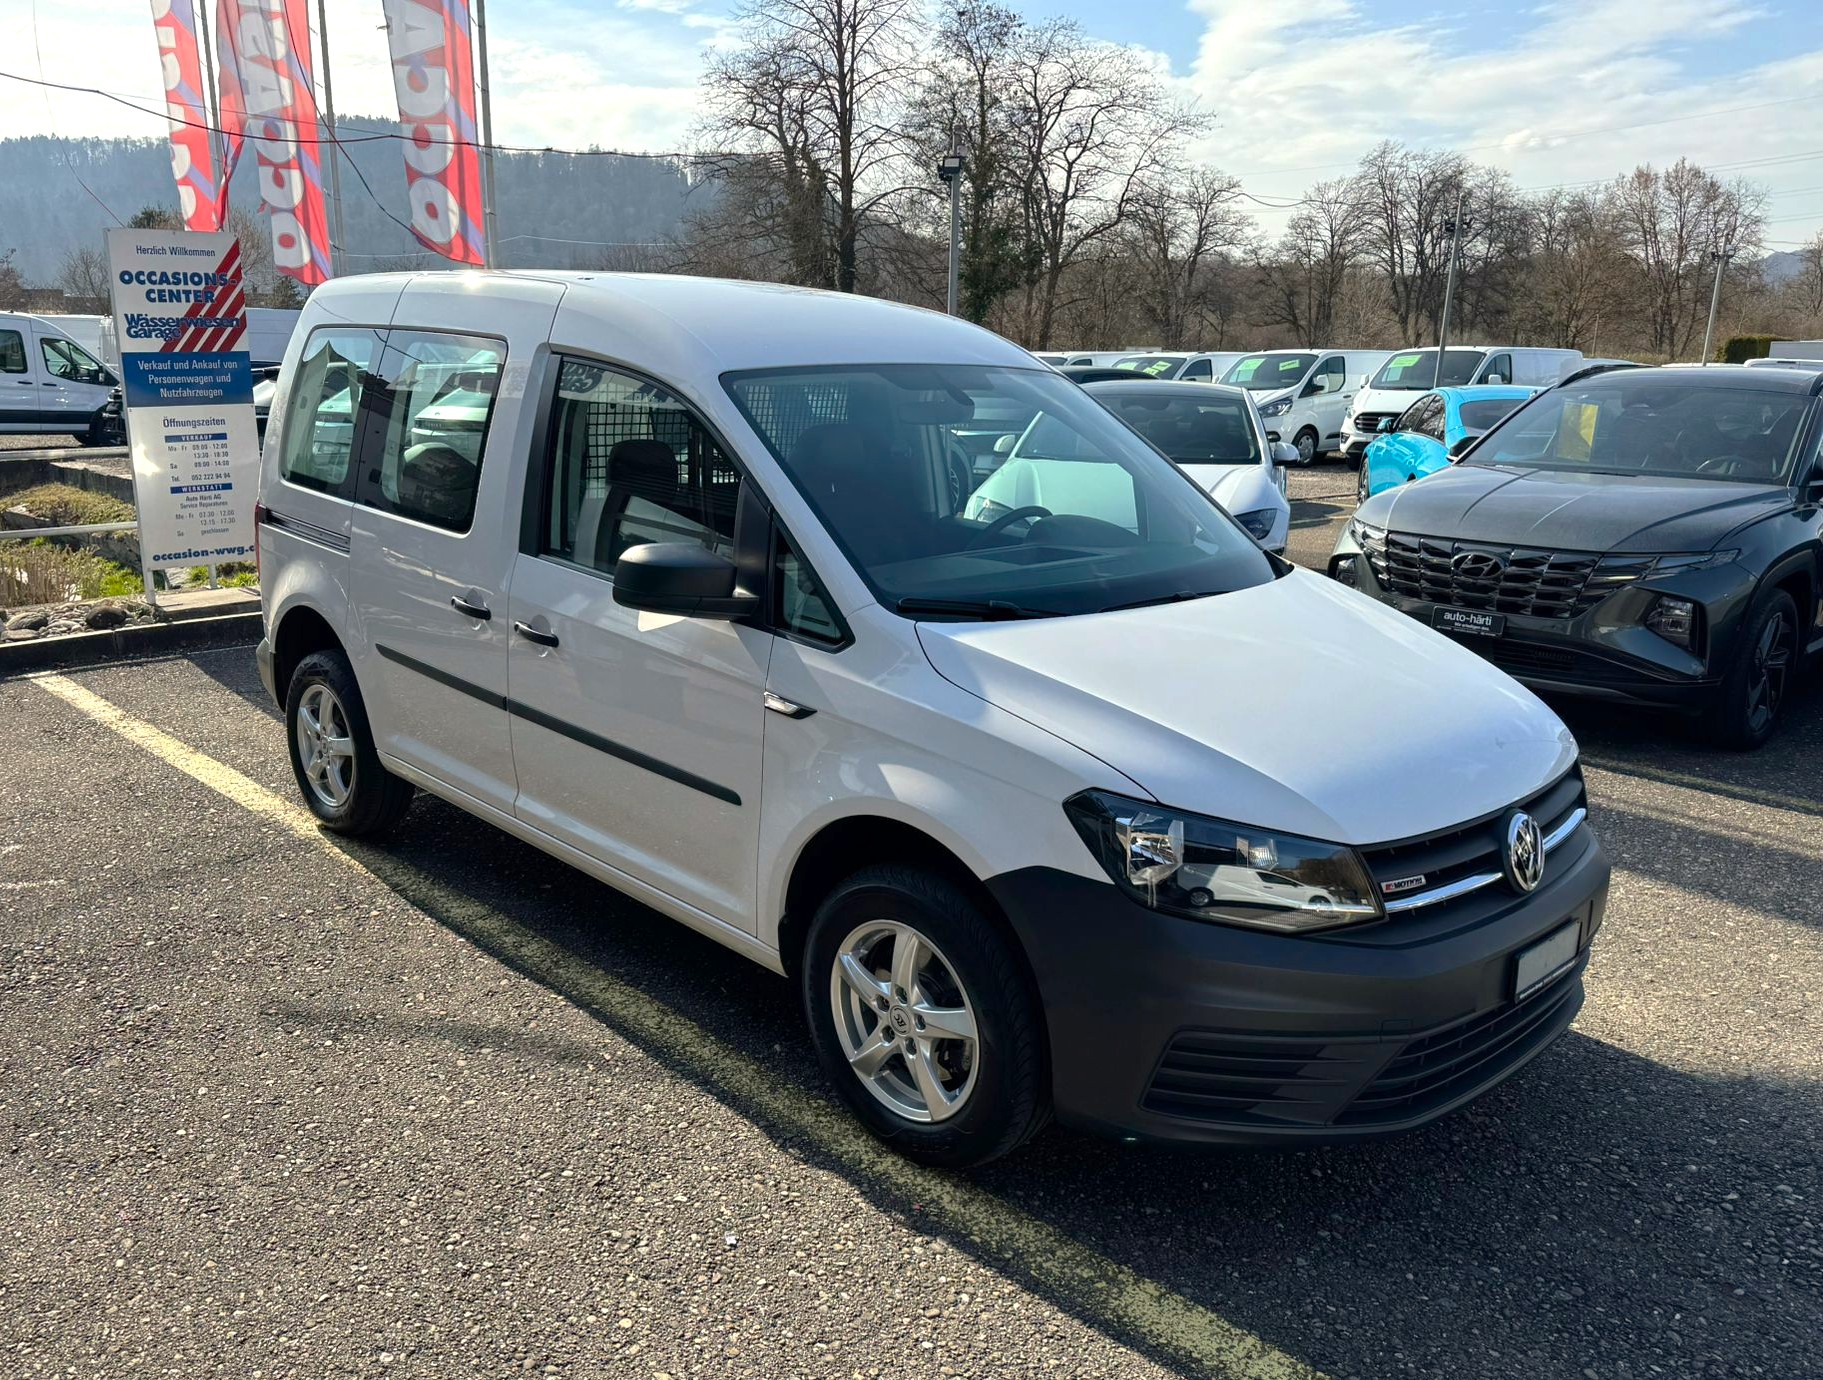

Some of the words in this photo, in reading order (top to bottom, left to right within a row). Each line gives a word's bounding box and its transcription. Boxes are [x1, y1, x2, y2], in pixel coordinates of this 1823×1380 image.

[136, 245, 167, 256] Herzlich
[168, 246, 216, 257] Willkommen
[119, 270, 237, 287] OCCASIONS-
[145, 288, 216, 304] CENTER
[126, 326, 182, 341] Garage
[137, 360, 171, 371] Verkauf
[173, 360, 189, 370] und
[191, 359, 221, 370] Ankauf
[223, 361, 238, 369] von
[148, 374, 214, 385] Personenwagen
[216, 374, 231, 383] und
[160, 388, 223, 398] Nutzfahrzeugen
[163, 416, 226, 429] Öffnungszeiten
[181, 484, 223, 493] WERKSTATT
[1443, 611, 1493, 626] auto-härti
